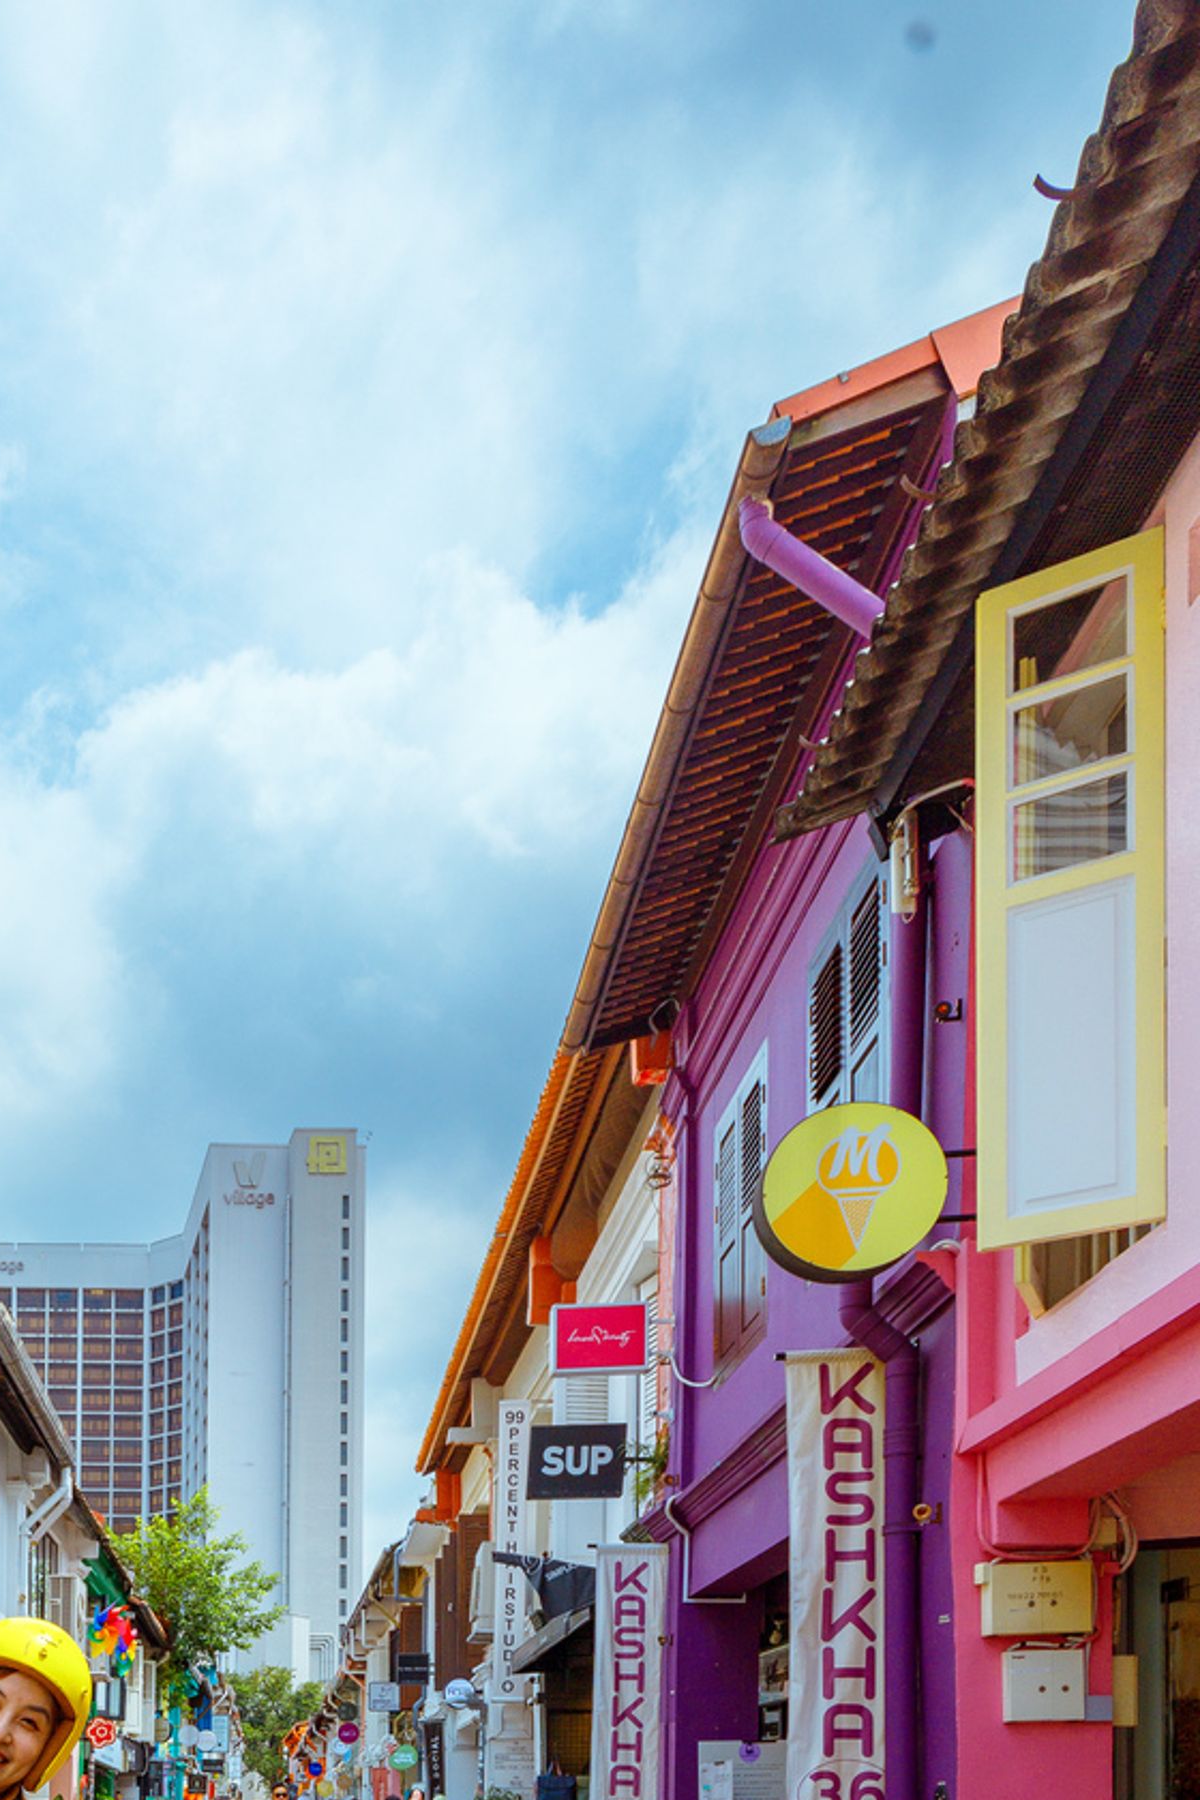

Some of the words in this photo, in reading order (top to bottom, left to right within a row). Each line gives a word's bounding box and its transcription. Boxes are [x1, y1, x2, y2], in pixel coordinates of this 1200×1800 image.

[223, 1187, 275, 1209] village
[505, 1411, 524, 1424] 99
[507, 1427, 519, 1533] PERCENT
[541, 1445, 614, 1477] SUP
[819, 1362, 876, 1758] KASHKHA
[609, 1561, 648, 1797] KASHKHA
